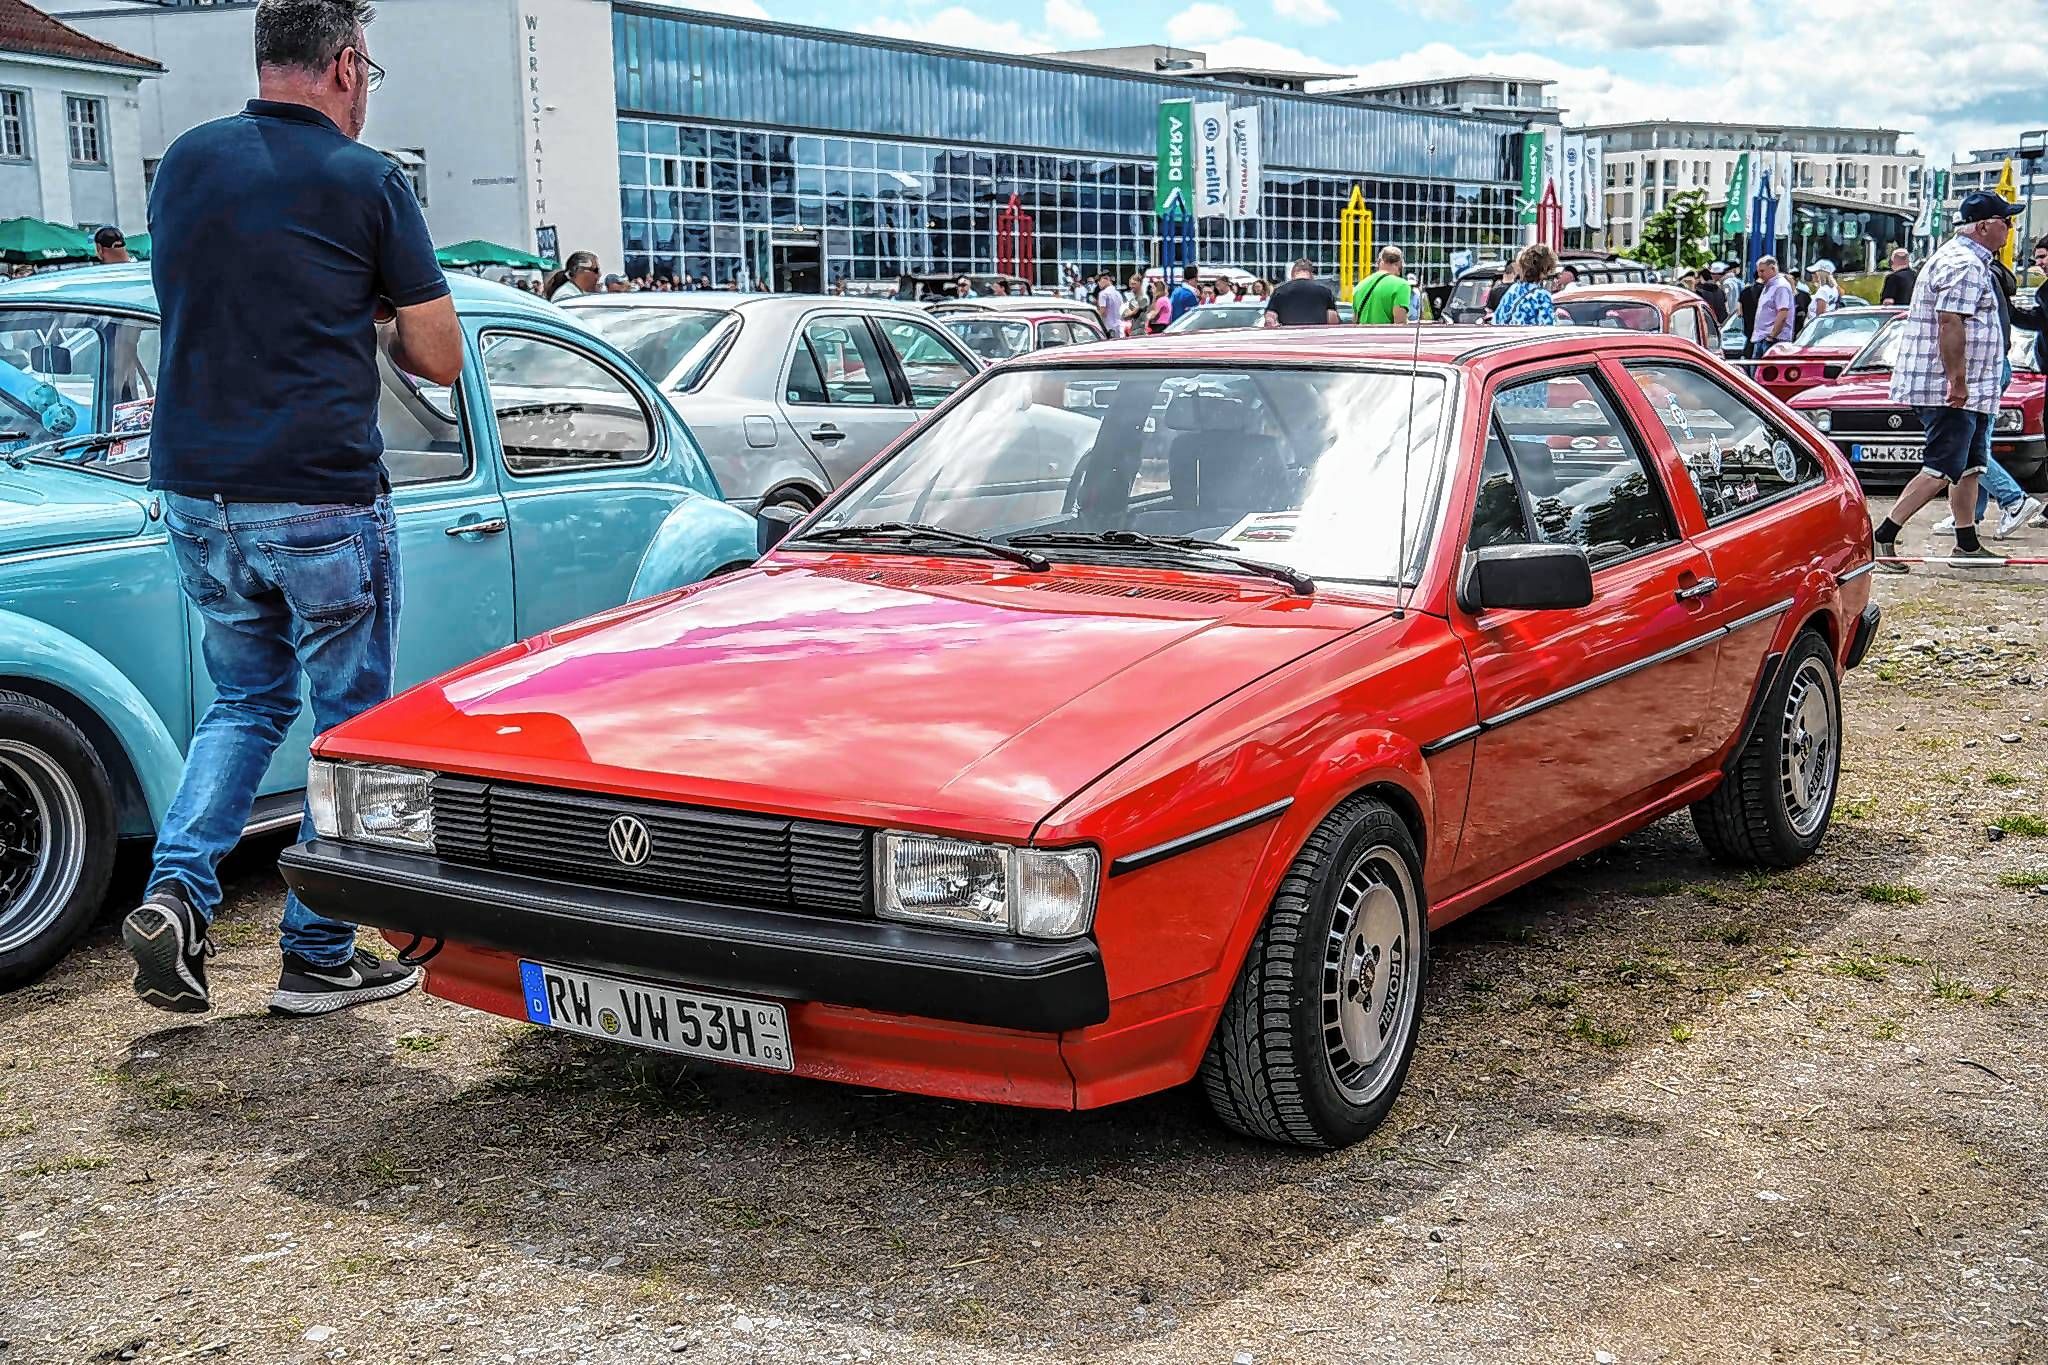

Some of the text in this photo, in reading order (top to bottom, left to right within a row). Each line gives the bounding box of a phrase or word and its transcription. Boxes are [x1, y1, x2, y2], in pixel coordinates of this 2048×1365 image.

[1861, 447, 1879, 460] CW
[1887, 447, 1896, 460] K
[608, 815, 650, 866] VW
[533, 999, 542, 1013] D
[545, 974, 593, 1028] RW
[619, 988, 670, 1043] VW
[677, 998, 757, 1058] 53H
[757, 1010, 778, 1028] 04
[763, 1044, 783, 1062] 09
